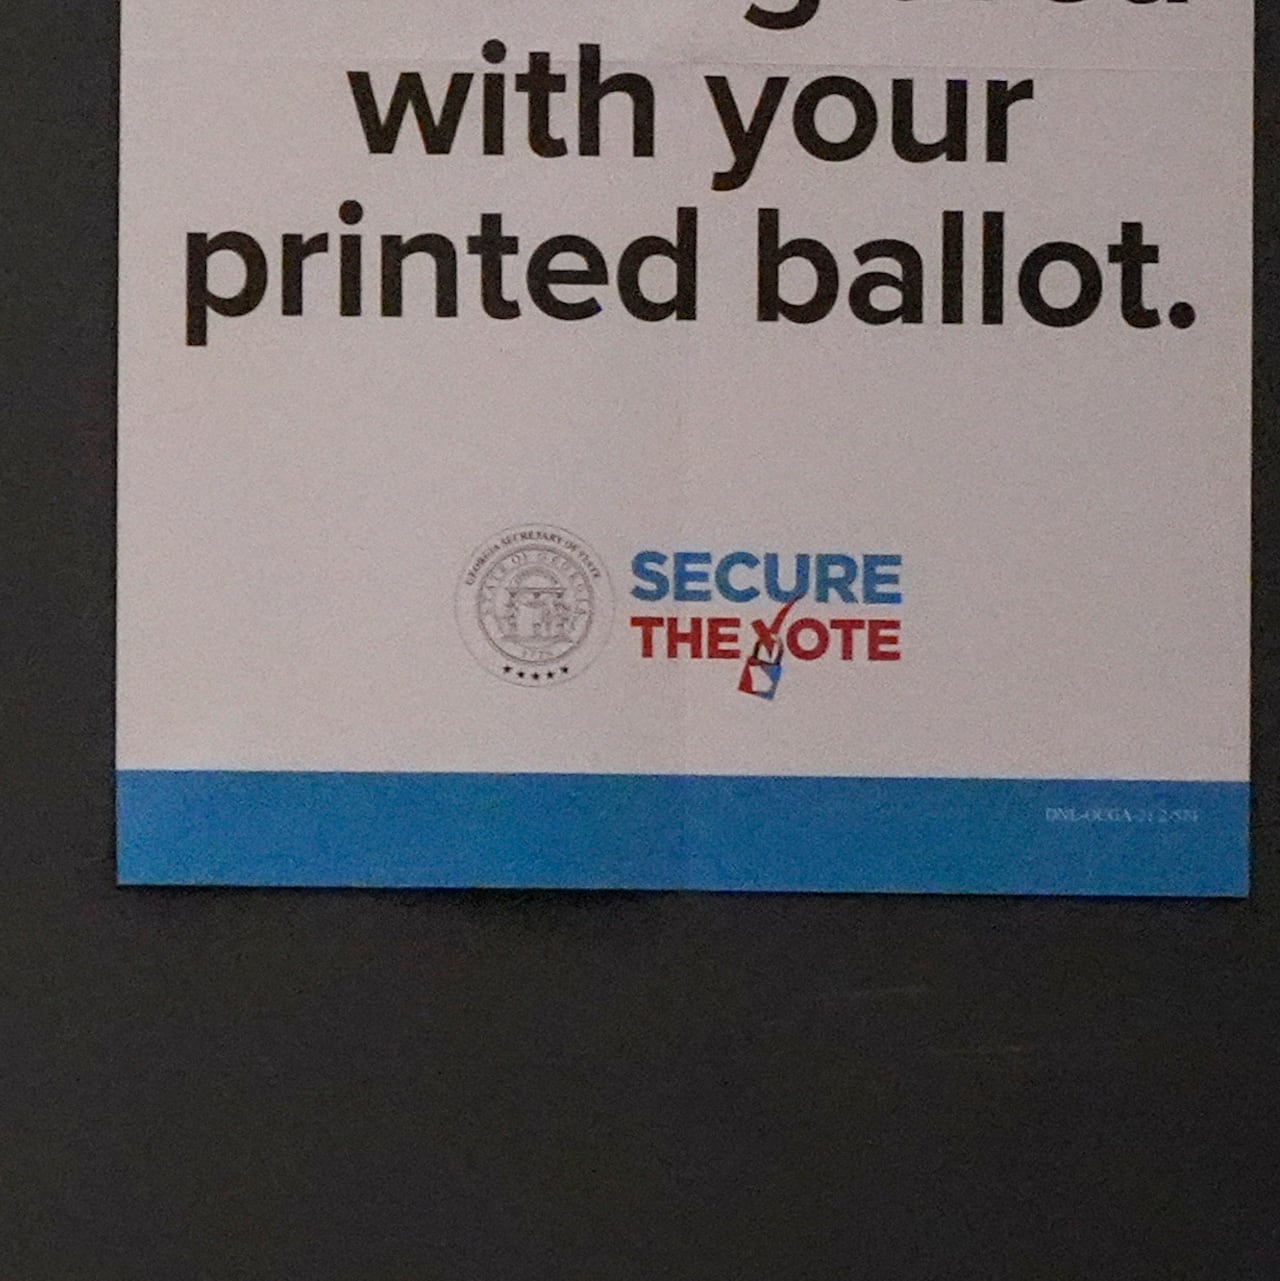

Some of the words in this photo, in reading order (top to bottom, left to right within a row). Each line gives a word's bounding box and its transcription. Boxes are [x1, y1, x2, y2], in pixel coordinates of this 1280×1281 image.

[346, 38, 656, 160] with
[703, 74, 1035, 193] your
[184, 199, 699, 348] printed
[756, 206, 1197, 331] ballot.
[629, 550, 903, 605] SECURE
[629, 616, 742, 660] THE
